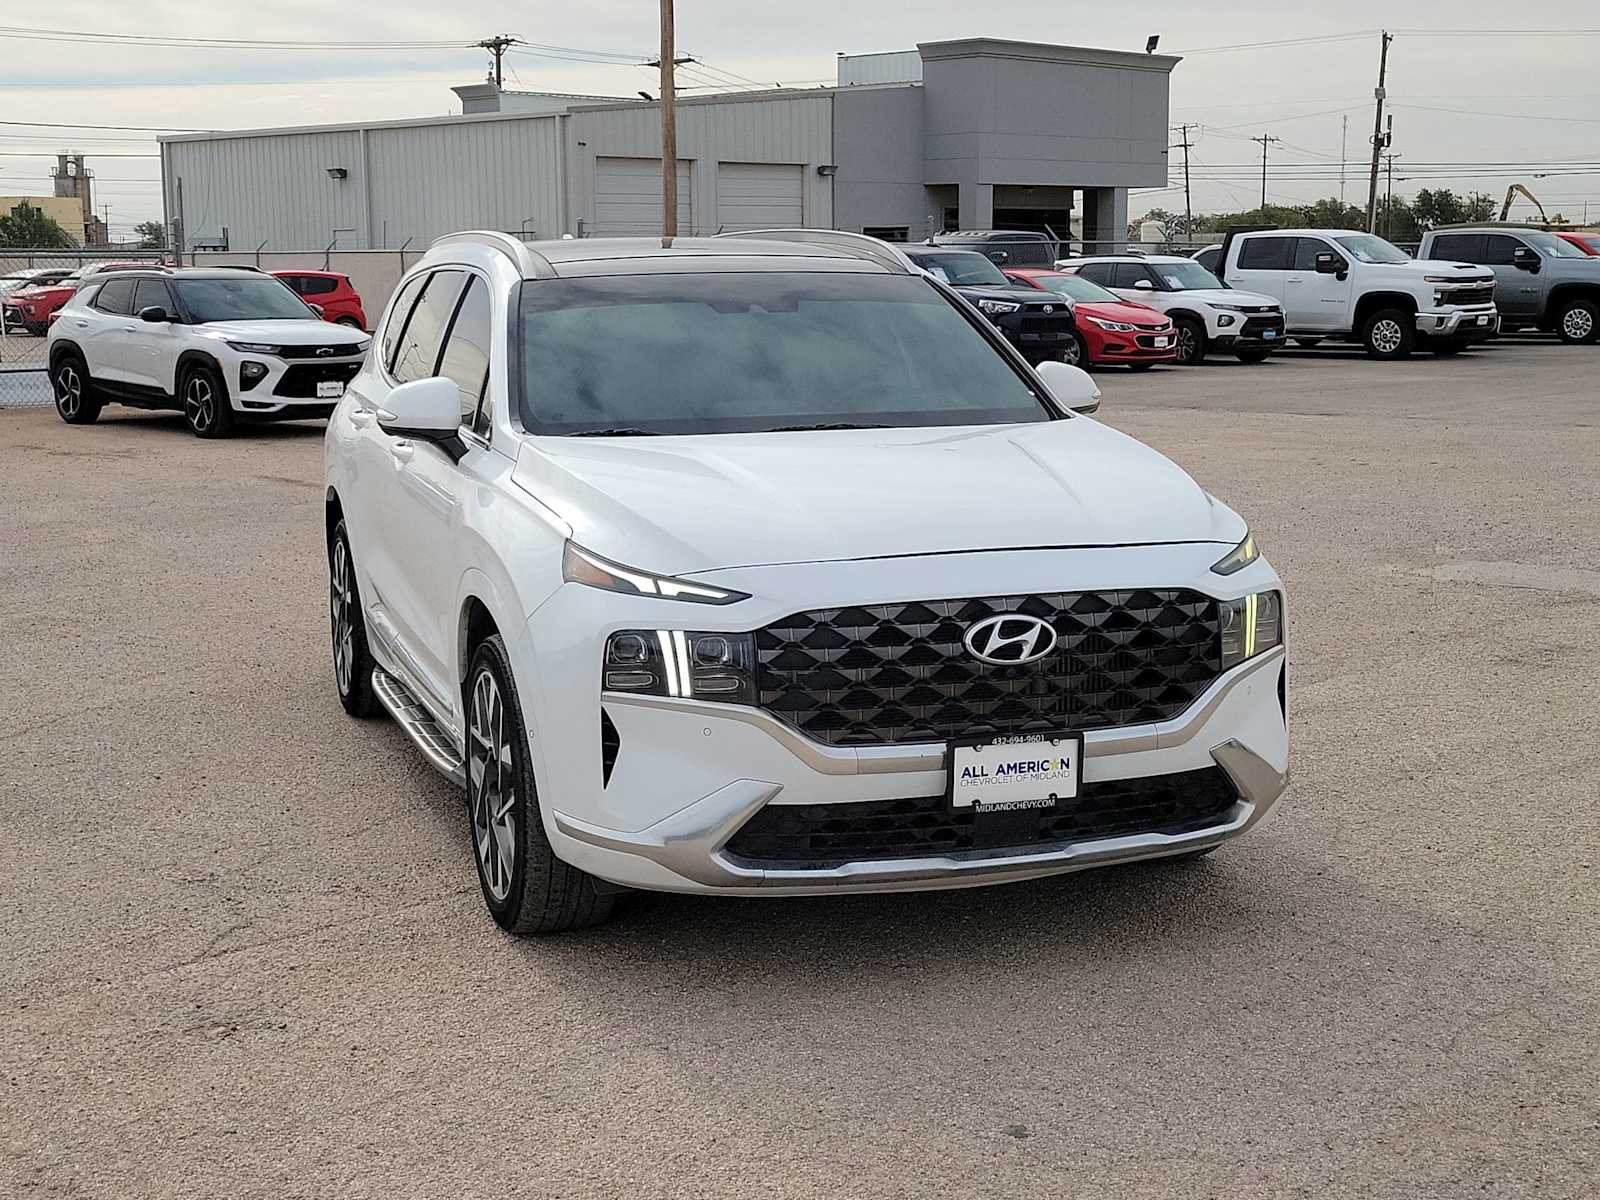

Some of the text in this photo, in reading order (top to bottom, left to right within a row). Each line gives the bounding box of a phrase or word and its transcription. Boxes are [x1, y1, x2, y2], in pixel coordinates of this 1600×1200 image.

[992, 734, 1045, 745] 432-694-9601
[960, 770, 1070, 787] CHEVROLET OF MIDLAND
[961, 766, 988, 779] ALL
[975, 799, 1055, 813] MIDLANDCHEVY.COM
